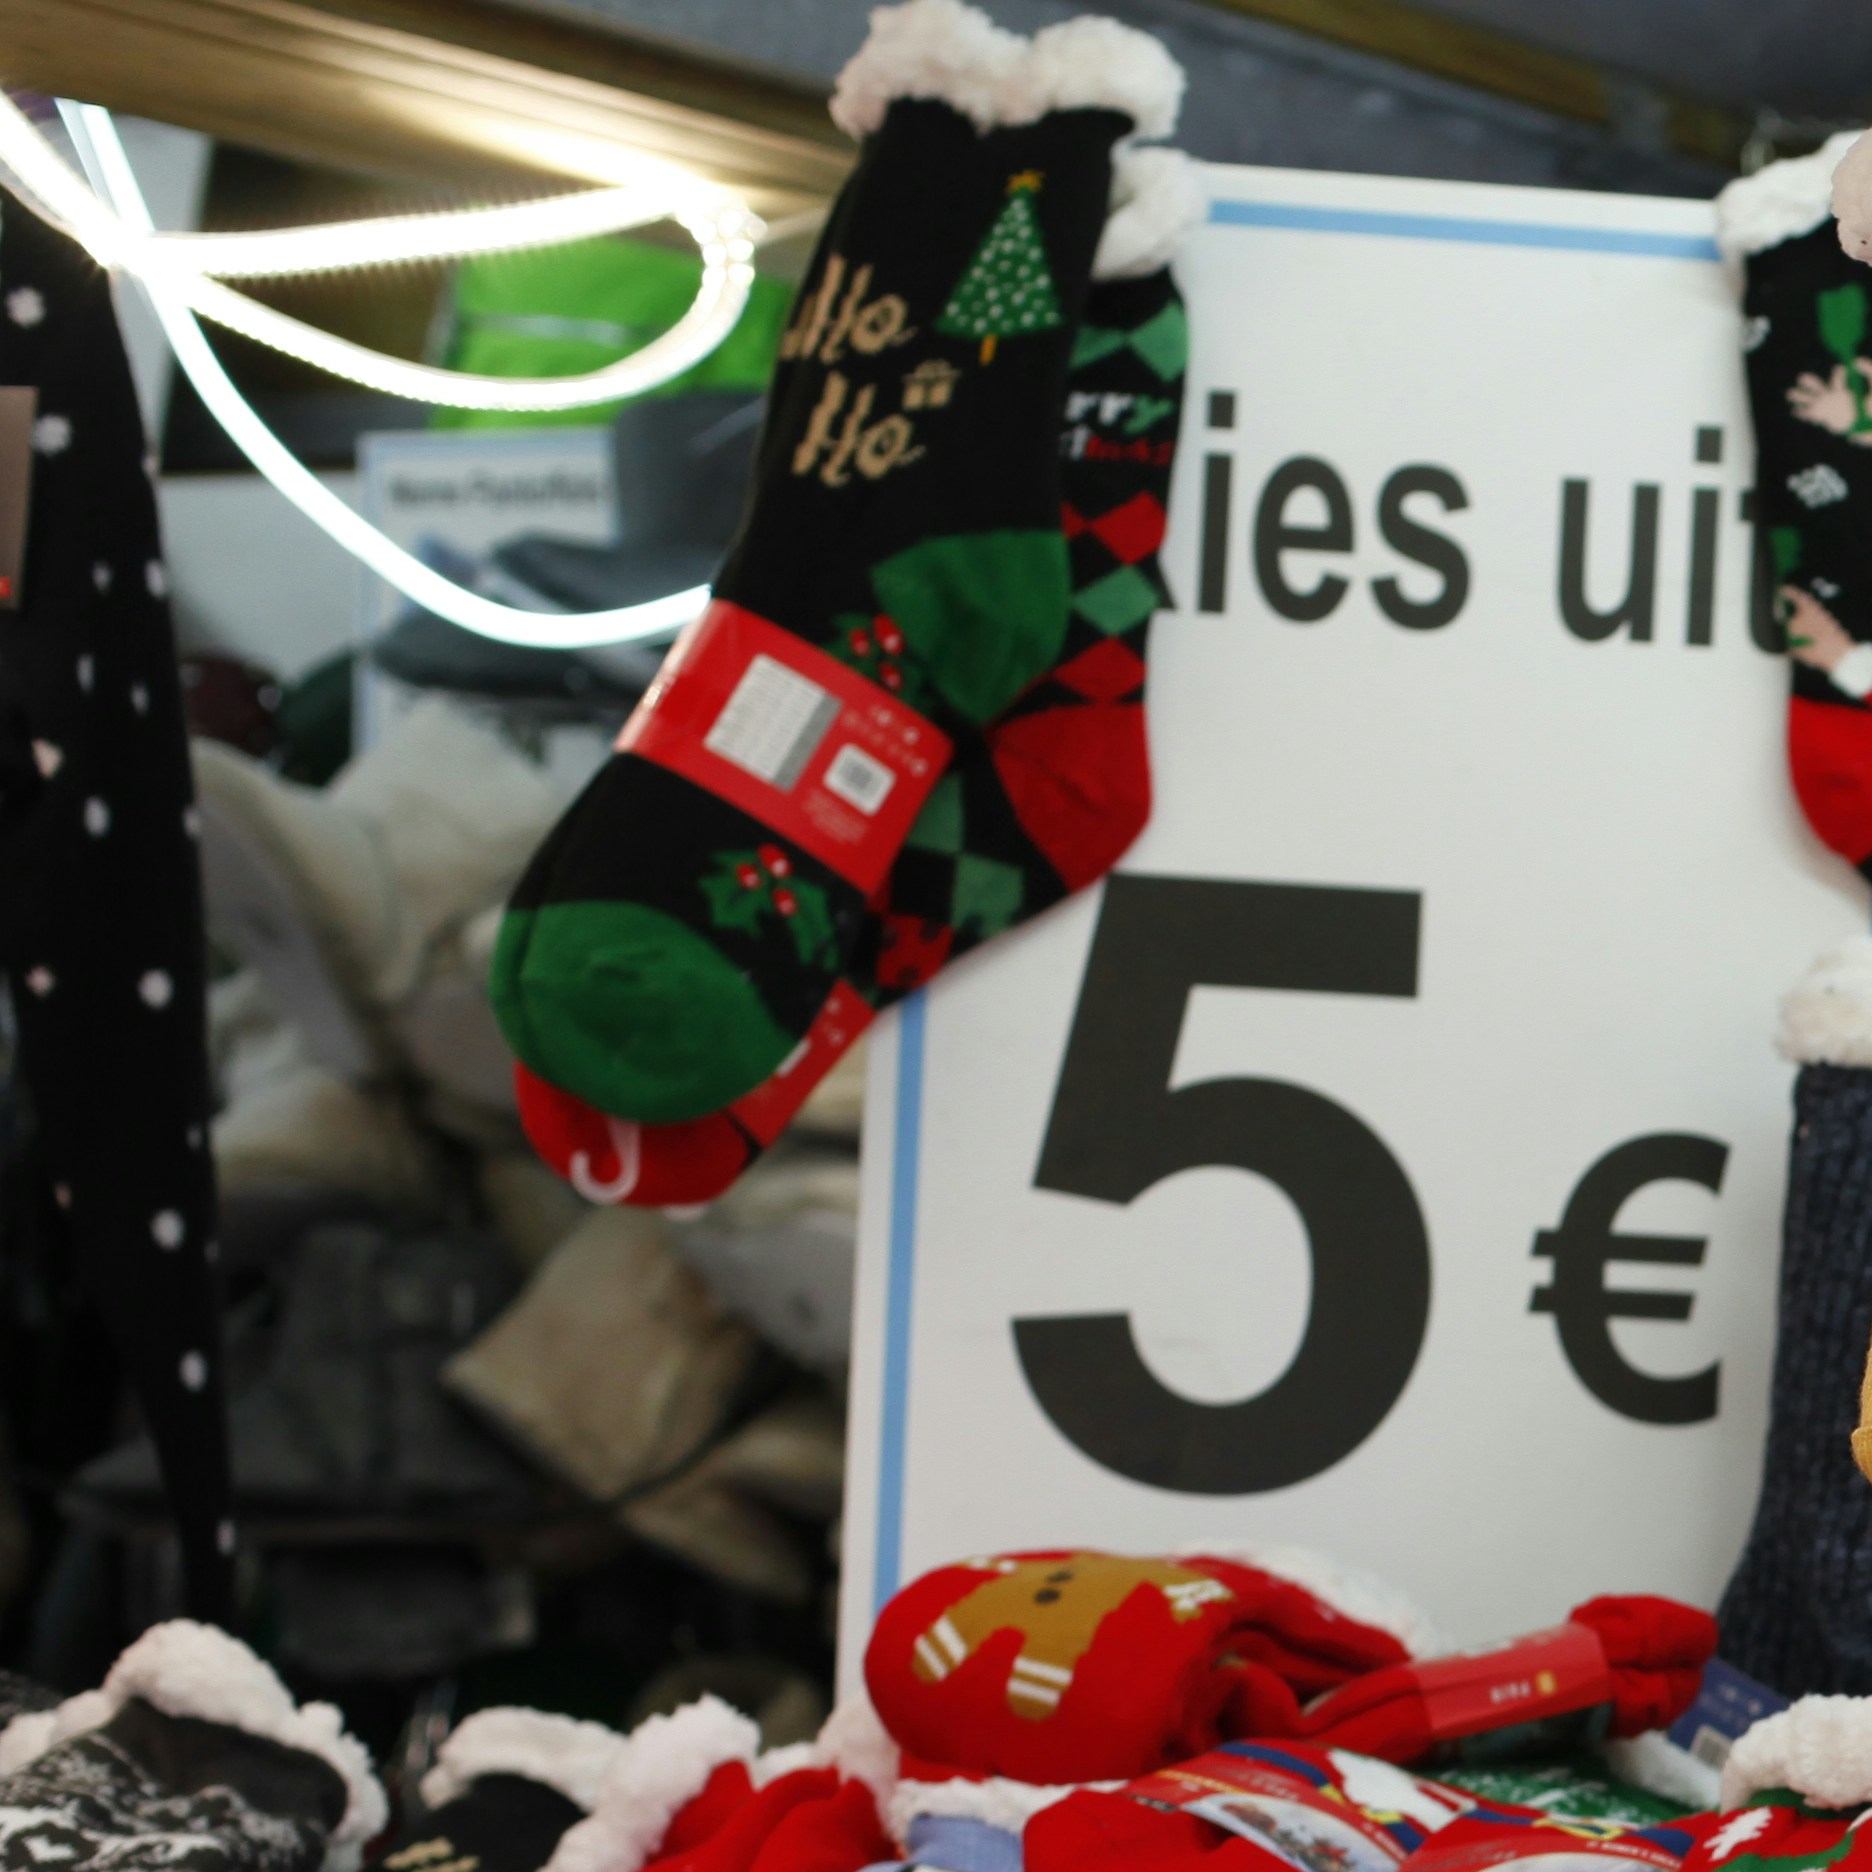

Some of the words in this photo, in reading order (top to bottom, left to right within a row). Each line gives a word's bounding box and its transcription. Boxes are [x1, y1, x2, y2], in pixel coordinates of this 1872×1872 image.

[1158, 389, 1472, 631] ies
[1010, 876, 1430, 1497] 5
[1529, 1130, 1728, 1426] €
